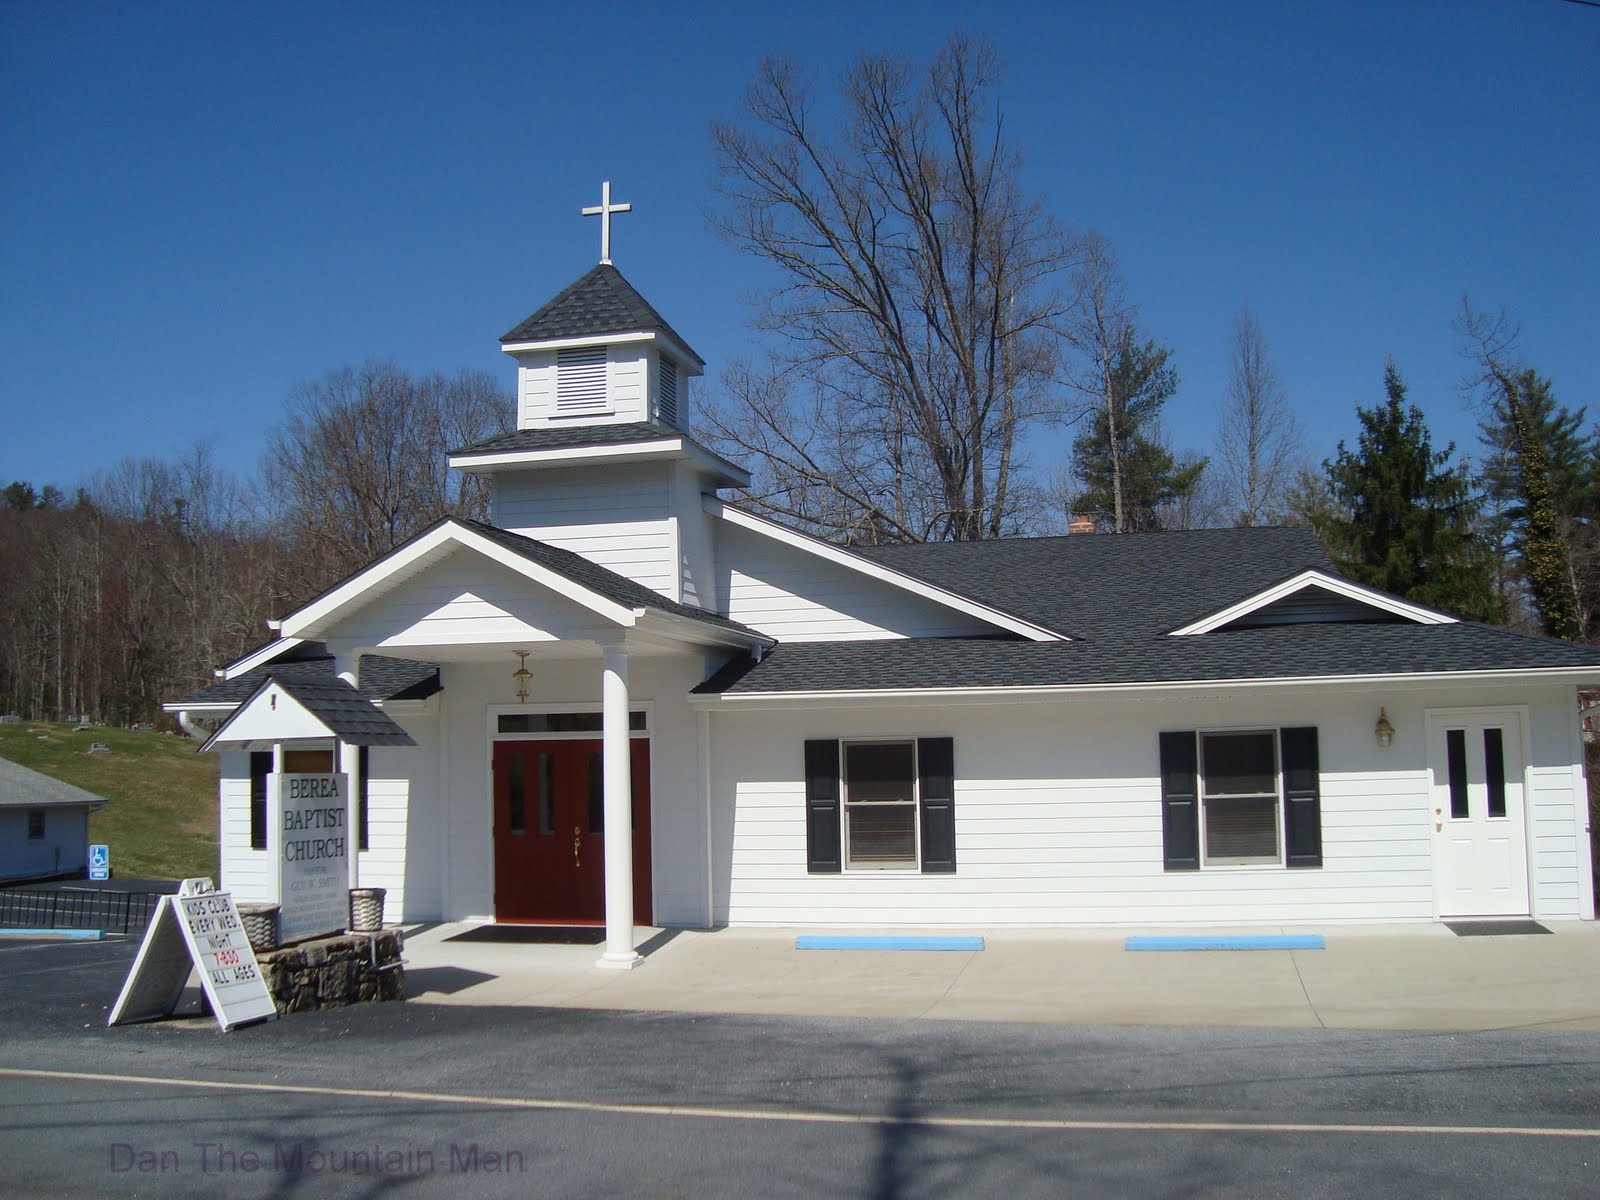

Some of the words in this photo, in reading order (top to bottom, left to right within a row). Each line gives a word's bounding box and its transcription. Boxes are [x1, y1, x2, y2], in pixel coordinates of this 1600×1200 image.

[290, 778, 339, 799] BEREA
[284, 808, 345, 831] BAPTIST
[285, 837, 344, 862] CHURCH
[187, 901, 206, 916] KIDS
[208, 899, 230, 914] CLUB
[189, 918, 216, 934] EVERY
[207, 933, 232, 950] NIGHT
[212, 970, 230, 984] ALL
[233, 964, 255, 981] AGES
